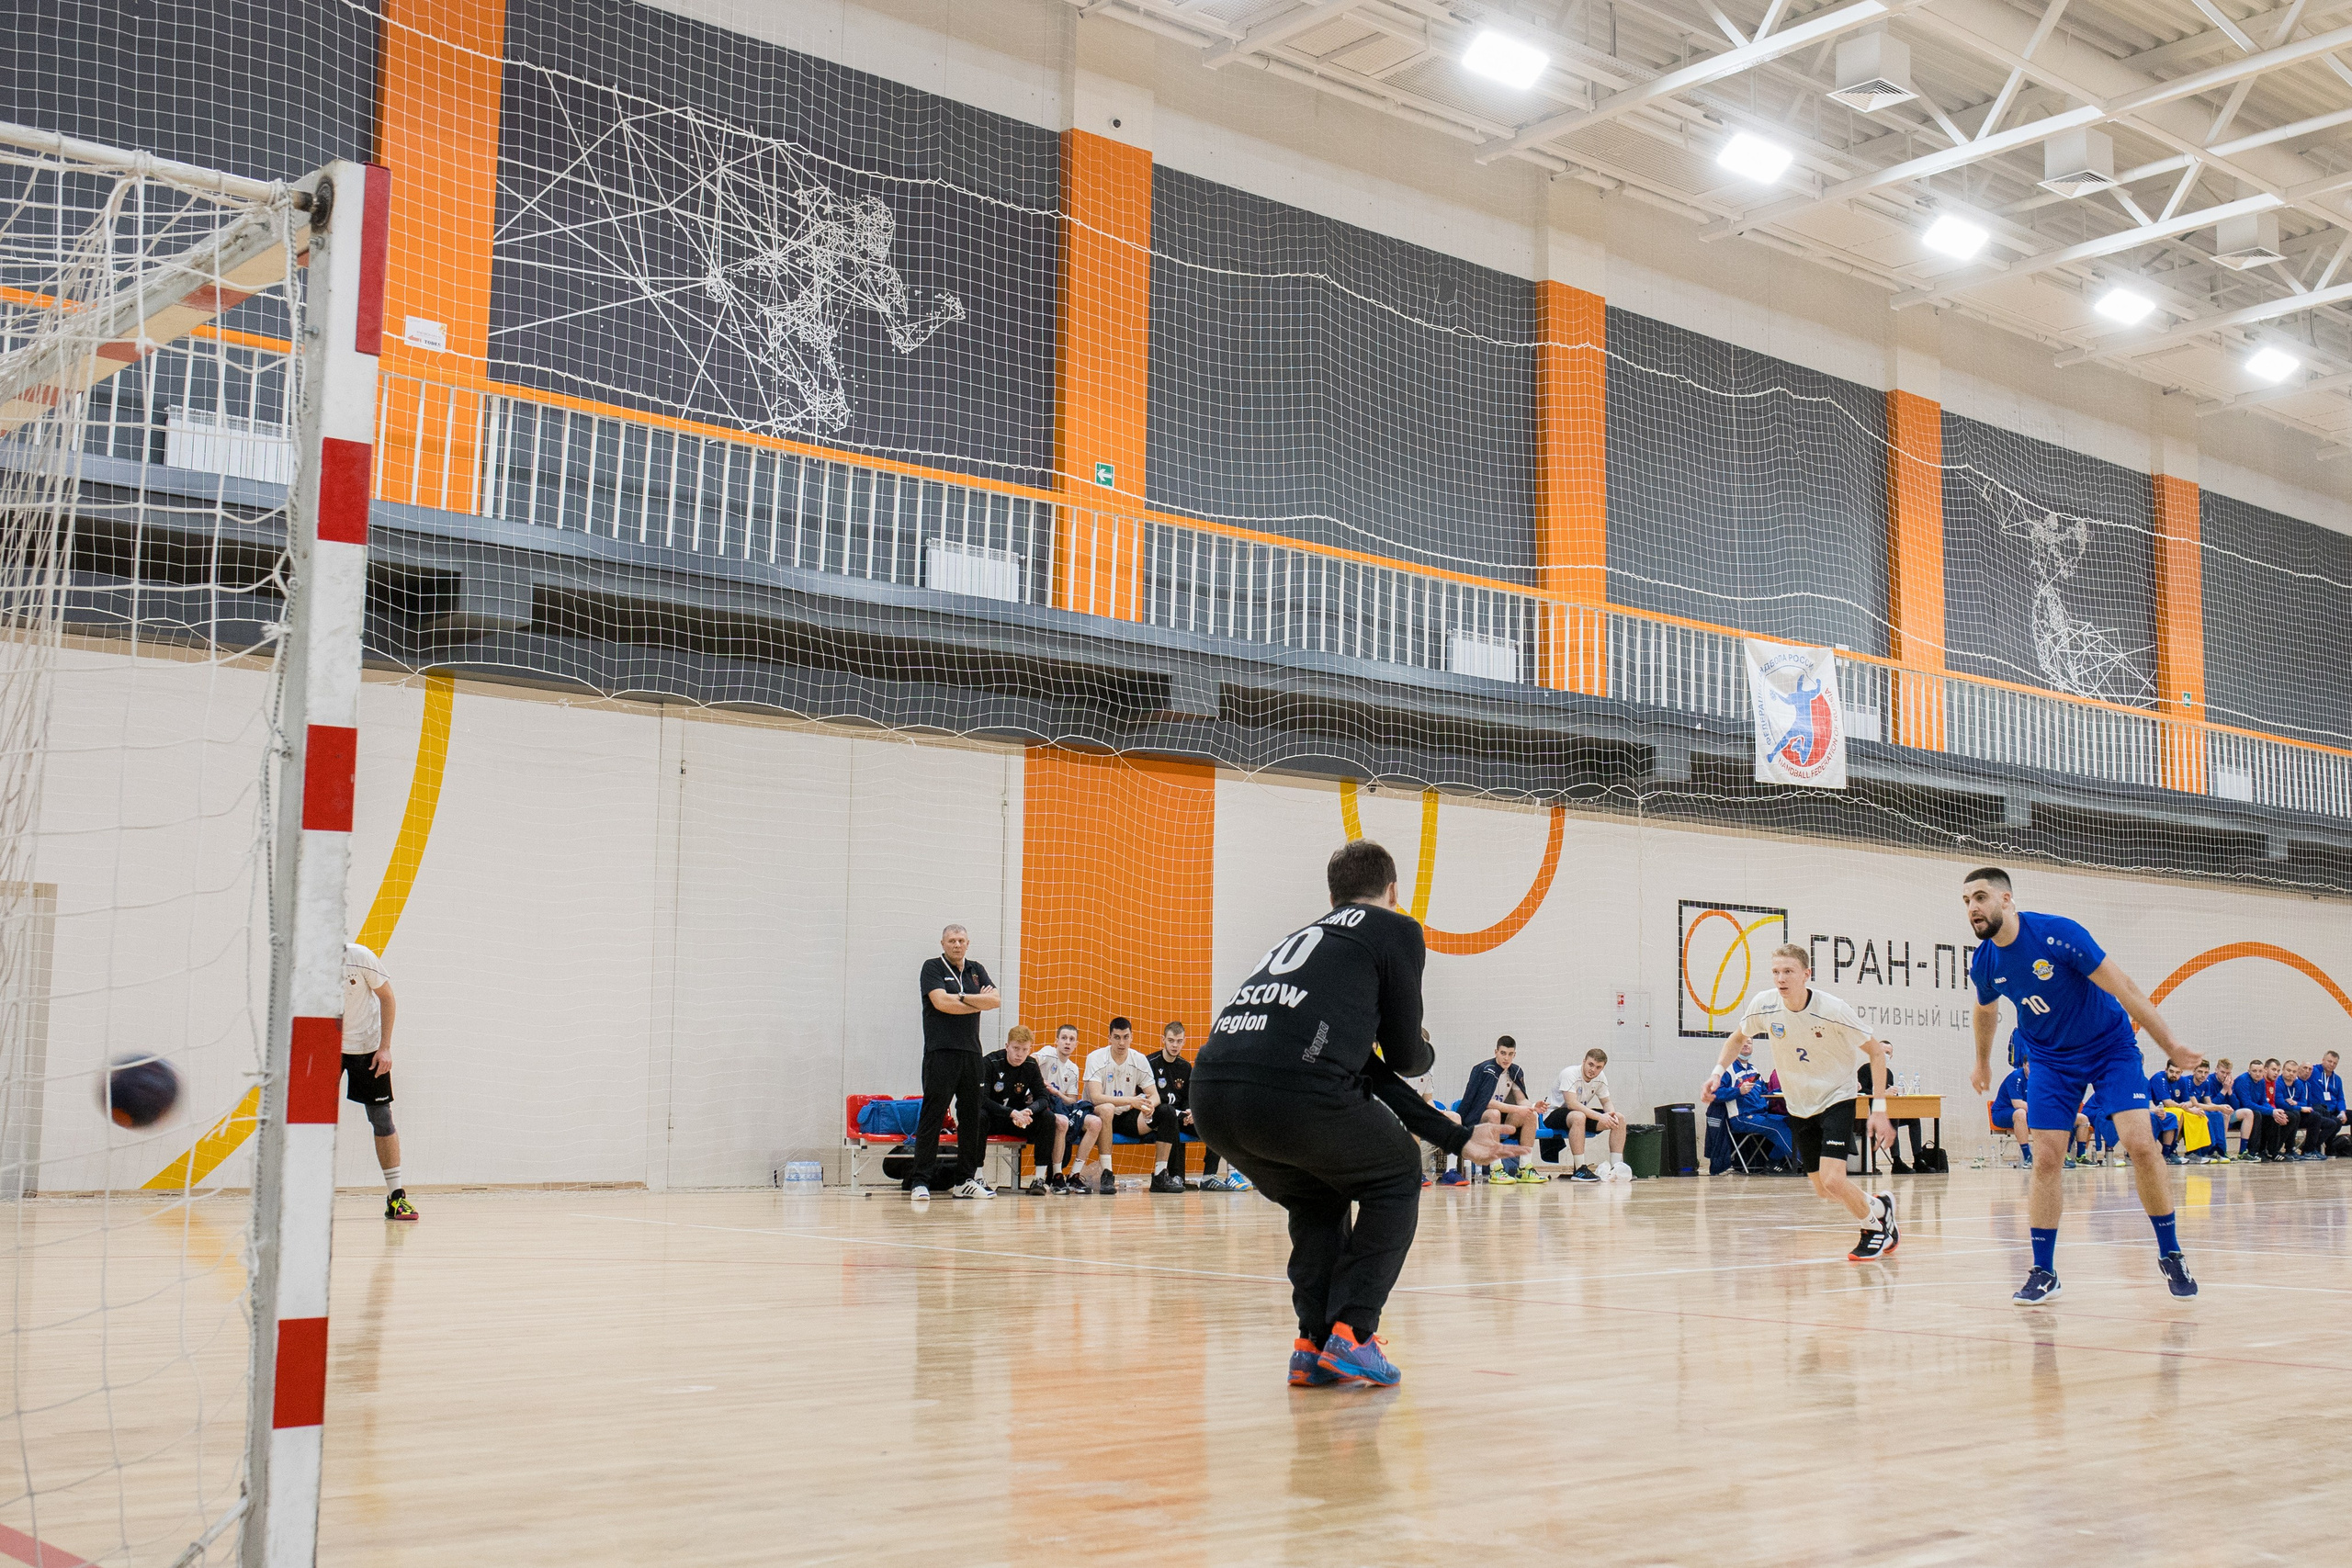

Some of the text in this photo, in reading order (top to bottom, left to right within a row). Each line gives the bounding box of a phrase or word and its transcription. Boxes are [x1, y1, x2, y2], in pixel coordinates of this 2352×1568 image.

[1778, 756, 1810, 779] HANDBALL
[1810, 738, 1838, 778] FEDERATION
[1810, 933, 1978, 990] ГРАН-ПР
[1857, 1005, 1942, 1028] РТИВНЫЙ
[2021, 995, 2051, 1016] 10
[1214, 1010, 1268, 1034] region
[1302, 1020, 1330, 1064] Kempa
[1795, 1047, 1810, 1063] 2
